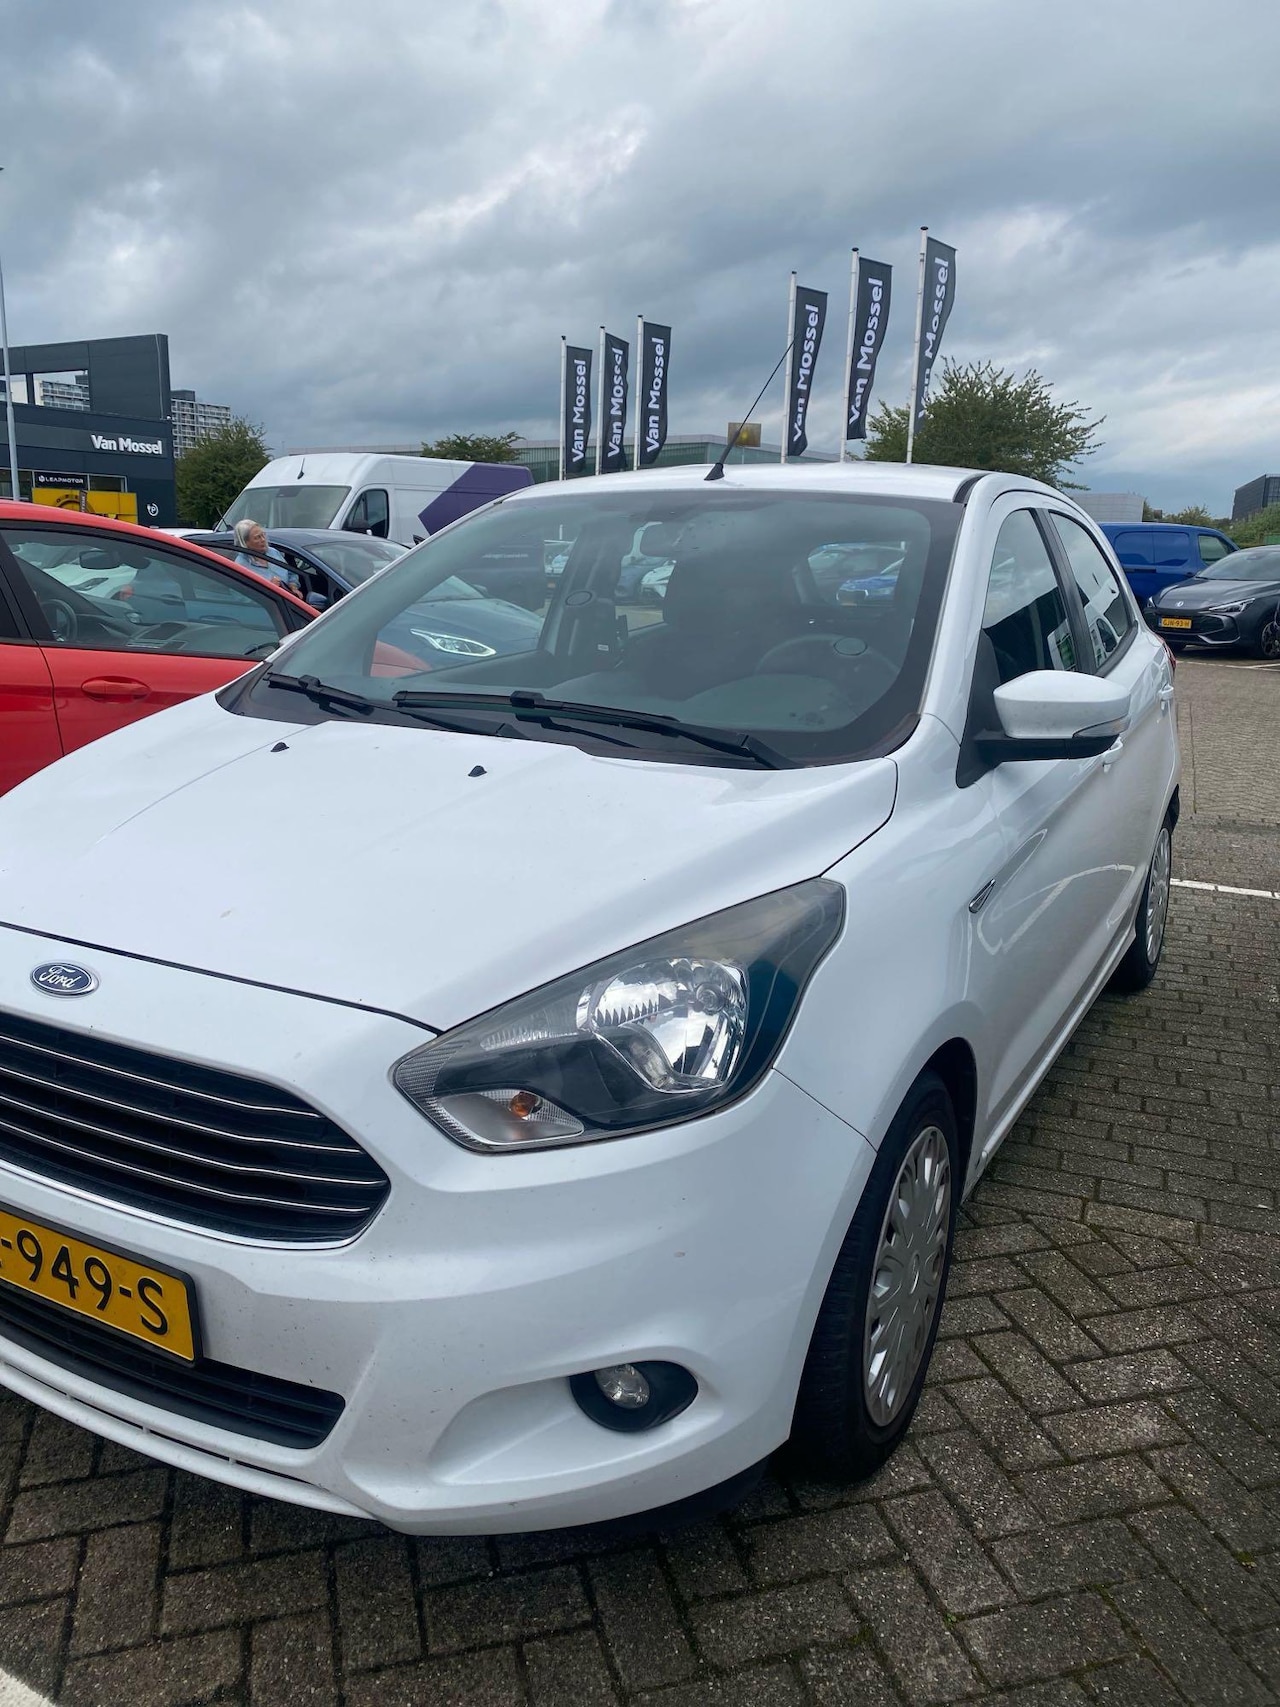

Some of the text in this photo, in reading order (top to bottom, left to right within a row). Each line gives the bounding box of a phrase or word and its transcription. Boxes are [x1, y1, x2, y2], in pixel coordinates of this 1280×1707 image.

[848, 277, 883, 425] Van Mossel
[924, 257, 949, 360] Mossel
[571, 359, 586, 462] Van Mossel
[646, 337, 665, 453] Van Mossel
[793, 304, 819, 442] Van Mossel
[91, 434, 163, 455] Van Mossel
[607, 421, 622, 457] Van
[39, 965, 82, 988] Ford
[0, 1229, 168, 1336] -949-S
